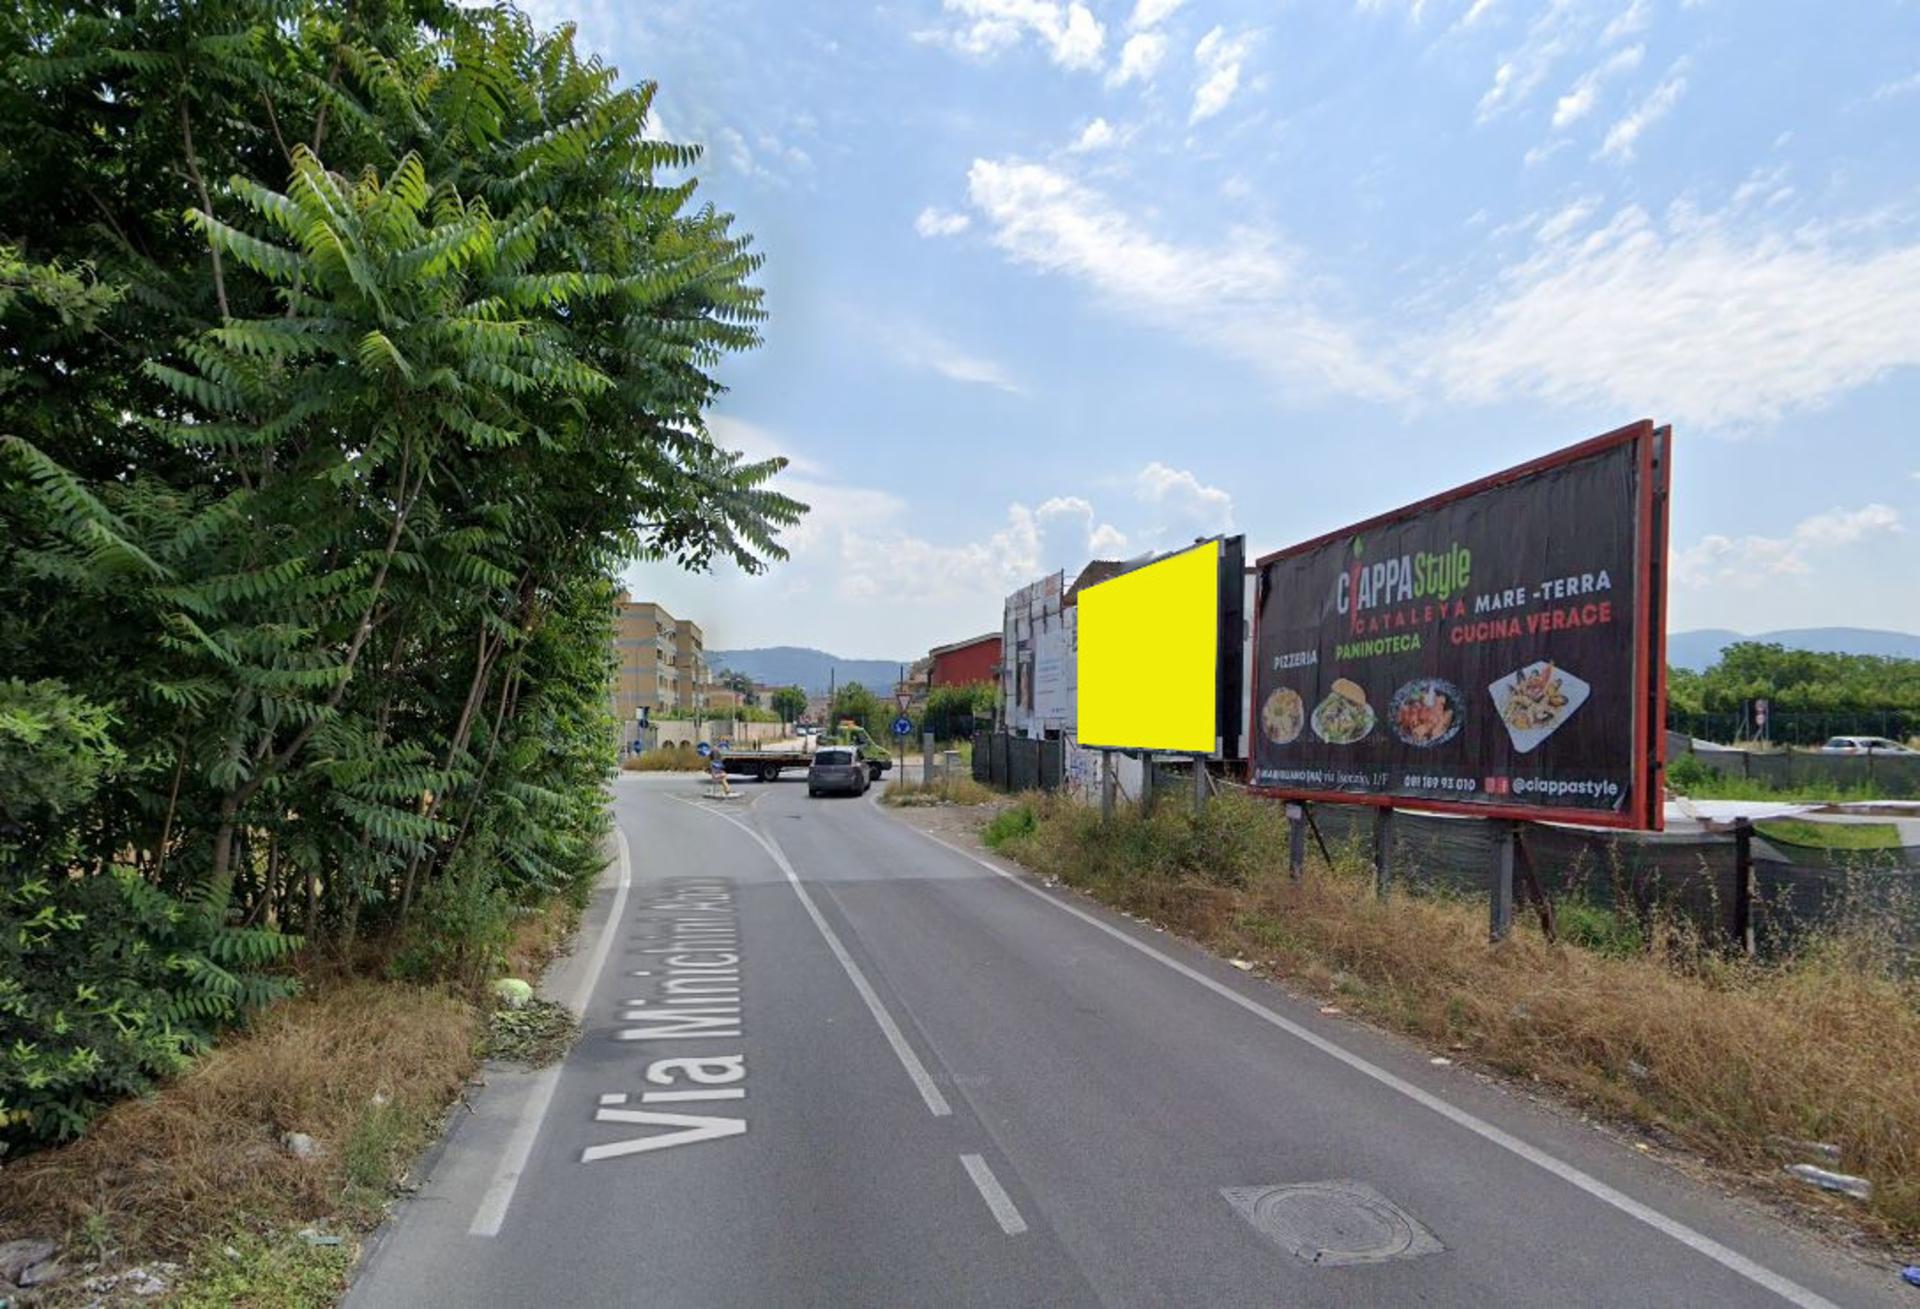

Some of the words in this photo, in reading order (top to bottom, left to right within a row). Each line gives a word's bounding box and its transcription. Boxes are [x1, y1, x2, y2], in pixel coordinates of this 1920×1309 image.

[1474, 587, 1526, 614] MARE
[1356, 596, 1465, 634] CATALEYA
[1451, 616, 1522, 645] CUCINA
[1527, 602, 1611, 634] VERACE
[1273, 649, 1318, 670] PIZZERIA
[1335, 633, 1421, 661] PANINOTECA
[1456, 778, 1476, 791] 010
[1512, 777, 1618, 797] @ciappastyle
